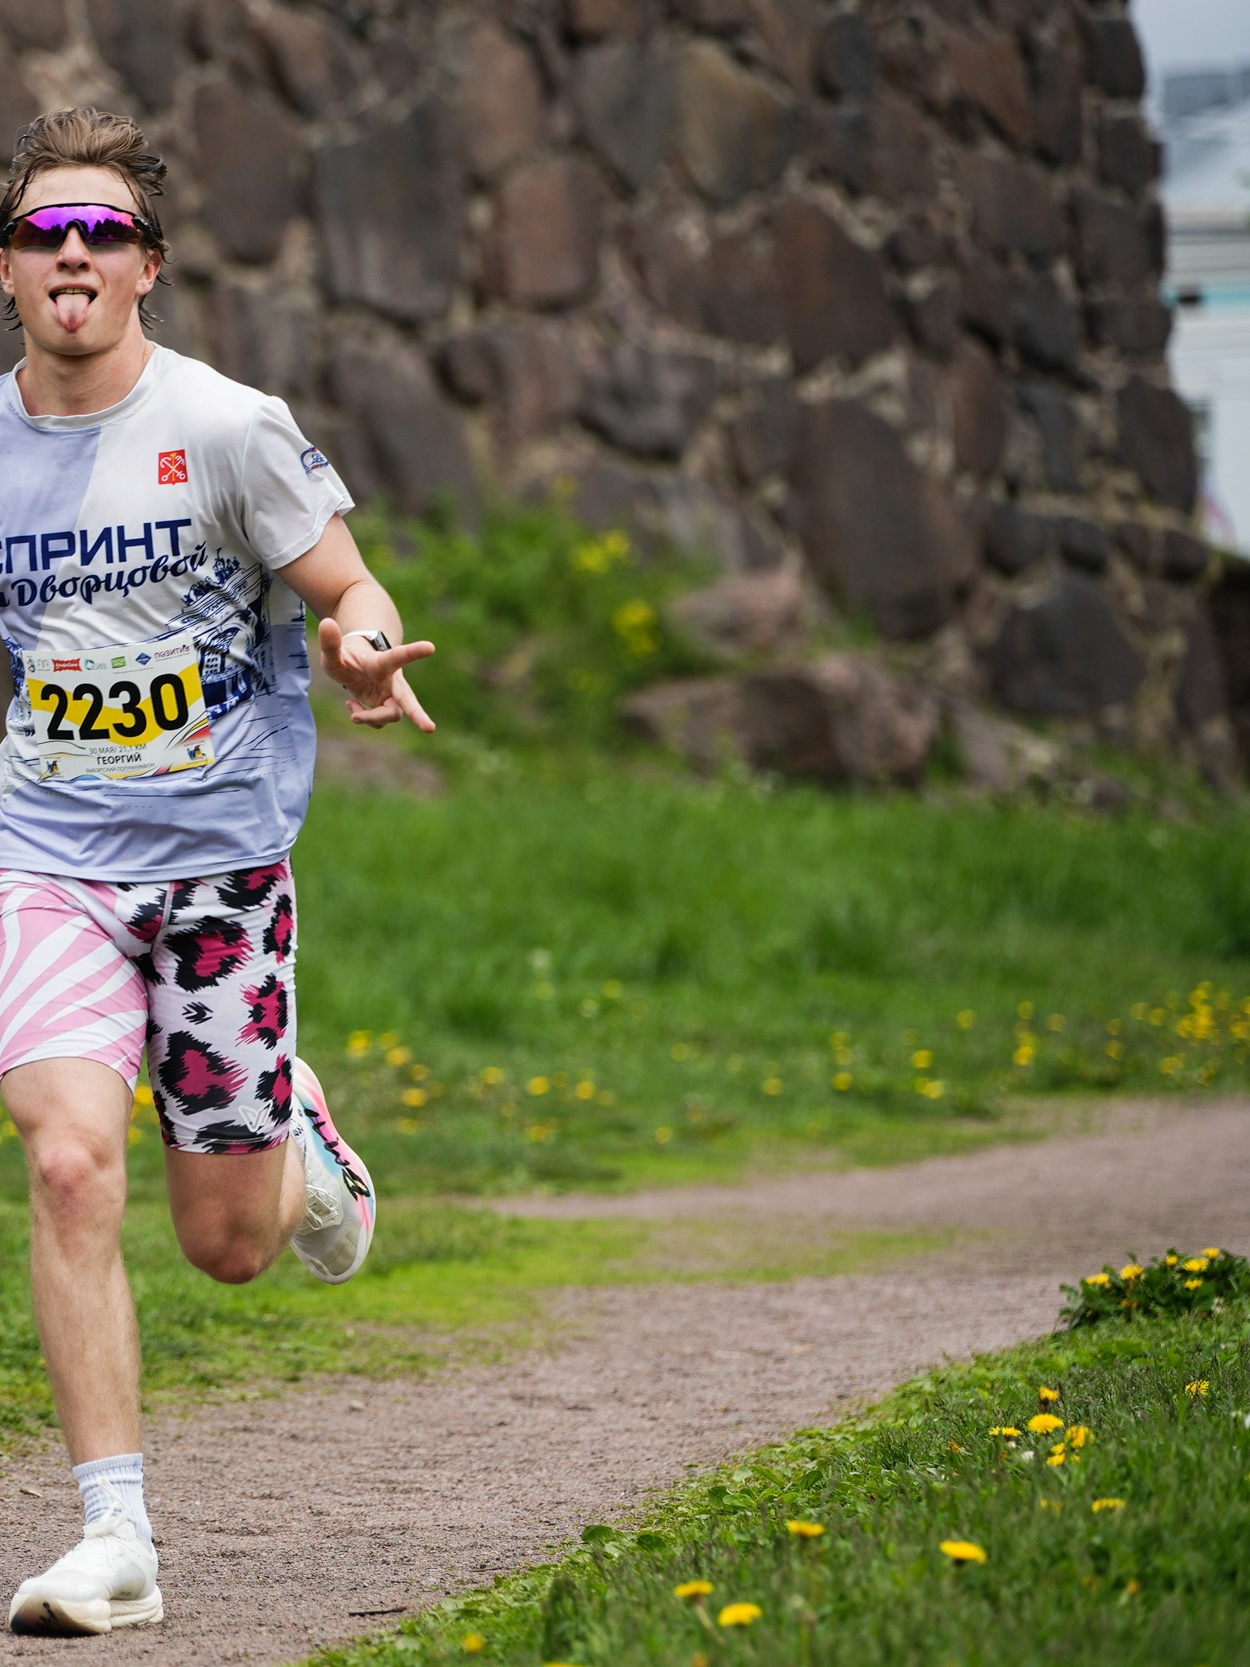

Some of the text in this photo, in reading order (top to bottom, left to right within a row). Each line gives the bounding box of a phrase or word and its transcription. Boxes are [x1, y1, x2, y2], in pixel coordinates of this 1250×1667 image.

[11, 541, 208, 607] Дворцовой
[41, 673, 189, 740] 2230
[97, 751, 142, 765] ГЕОРГИЙ
